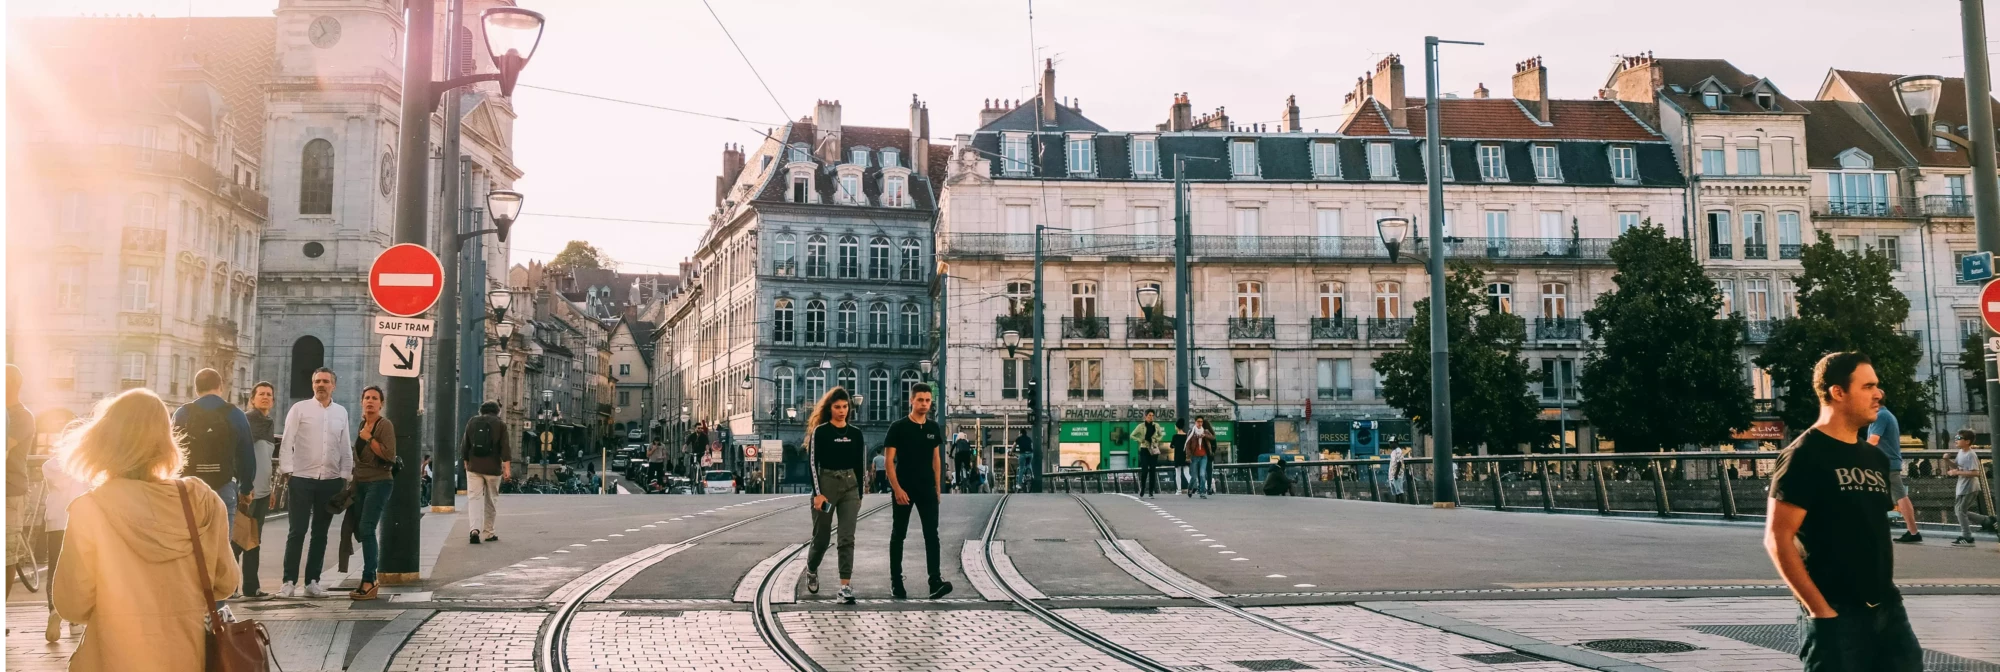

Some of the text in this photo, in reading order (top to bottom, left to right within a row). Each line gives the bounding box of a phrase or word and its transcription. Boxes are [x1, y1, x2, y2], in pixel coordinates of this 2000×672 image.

[378, 321, 430, 332] SAUF TRAM
[1065, 409, 1175, 419] PHARMACIE DES UAIS
[1834, 467, 1886, 488] BOSS
